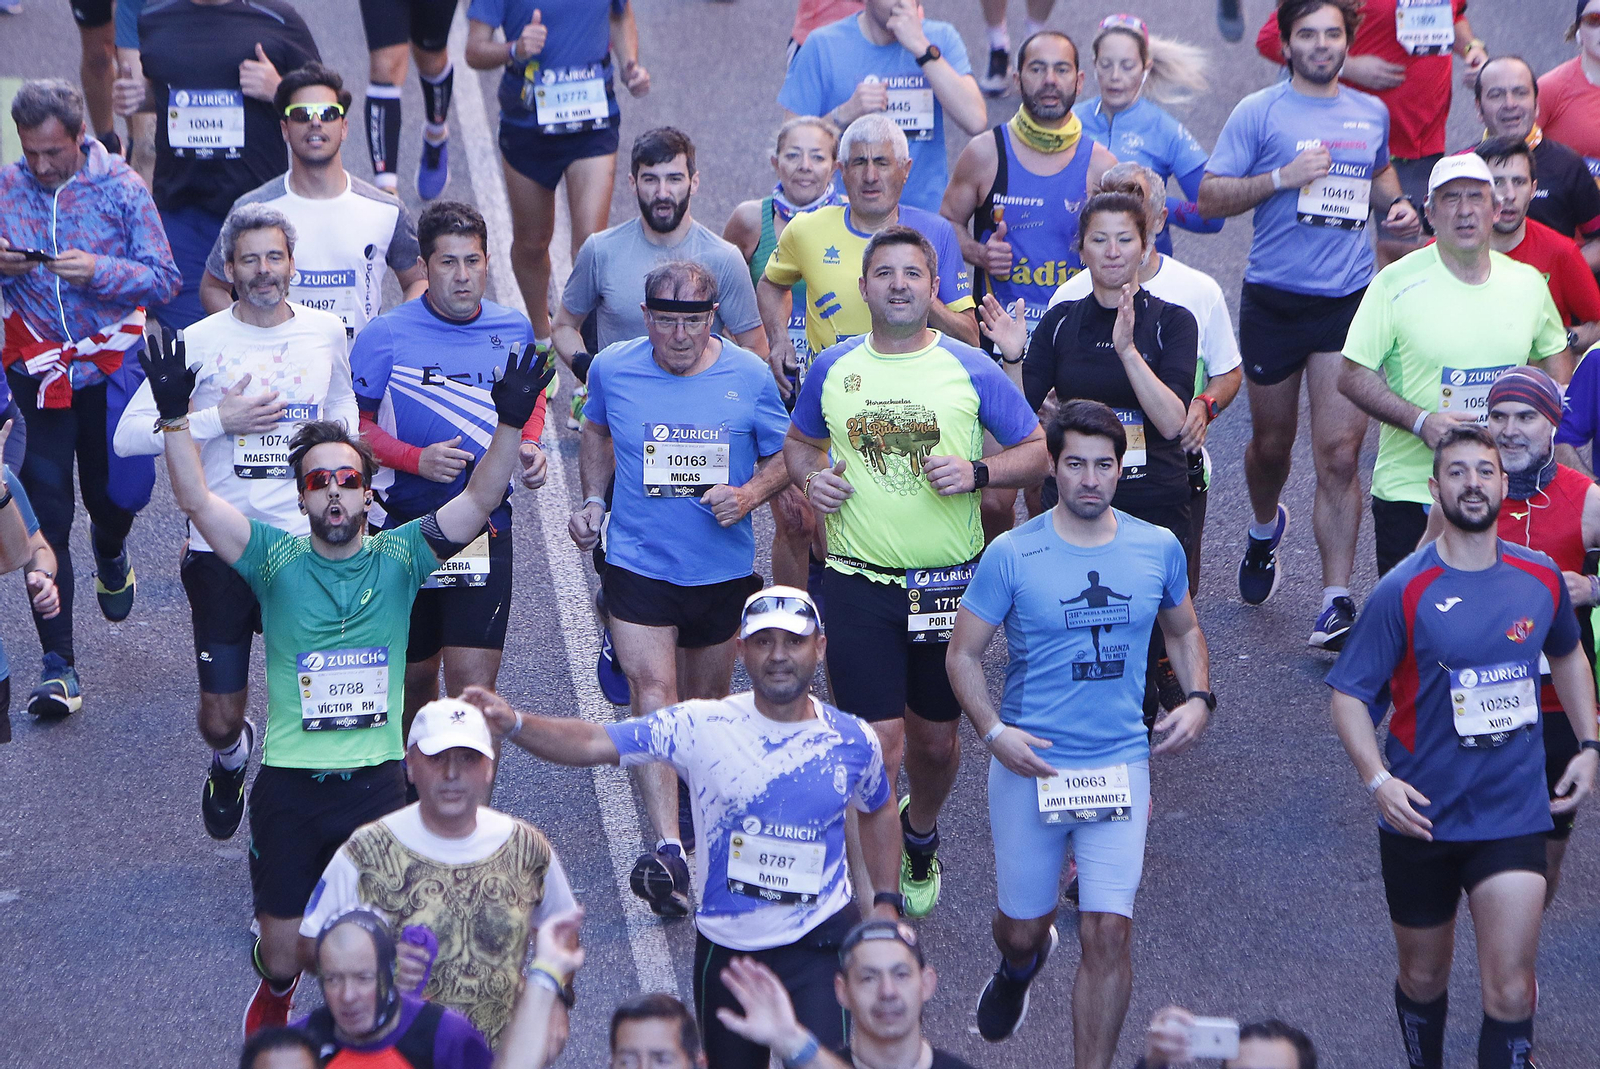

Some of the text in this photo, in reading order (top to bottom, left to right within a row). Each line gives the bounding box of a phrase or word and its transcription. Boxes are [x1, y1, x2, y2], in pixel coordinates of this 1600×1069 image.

[880, 76, 924, 88] ZURICH
[191, 94, 235, 106] ZURICH
[189, 118, 223, 129] 10044
[187, 135, 222, 144] CHARLIE
[1327, 162, 1368, 178] ZURICH
[992, 193, 1045, 207] Runners
[303, 273, 347, 286] ZURICH
[283, 408, 310, 420] RICH
[846, 417, 867, 437] 21
[868, 422, 902, 437] Ruta
[911, 420, 939, 434] Miel
[259, 434, 290, 447] 1074
[671, 428, 720, 440] ZURICH
[243, 453, 288, 463] MAESTRO
[666, 454, 708, 467] 10163
[670, 472, 702, 483] MICAS
[836, 558, 868, 569] Kalenji
[932, 568, 973, 583] ZURICH
[928, 615, 958, 627] POR L
[1101, 643, 1130, 653] ALCANZA
[326, 652, 378, 668] ZURICH
[1104, 652, 1128, 661] TU META
[1480, 664, 1528, 684] ZURICH
[328, 682, 364, 697] 8788
[317, 700, 375, 715] VÍCTOR RH
[1480, 695, 1520, 713] 10253
[1065, 776, 1107, 789] 10663
[1044, 793, 1128, 808] JAVI FERNANDEZ
[764, 824, 817, 842] ZURICH
[759, 852, 797, 870] 8787
[758, 872, 789, 887] DAVID
